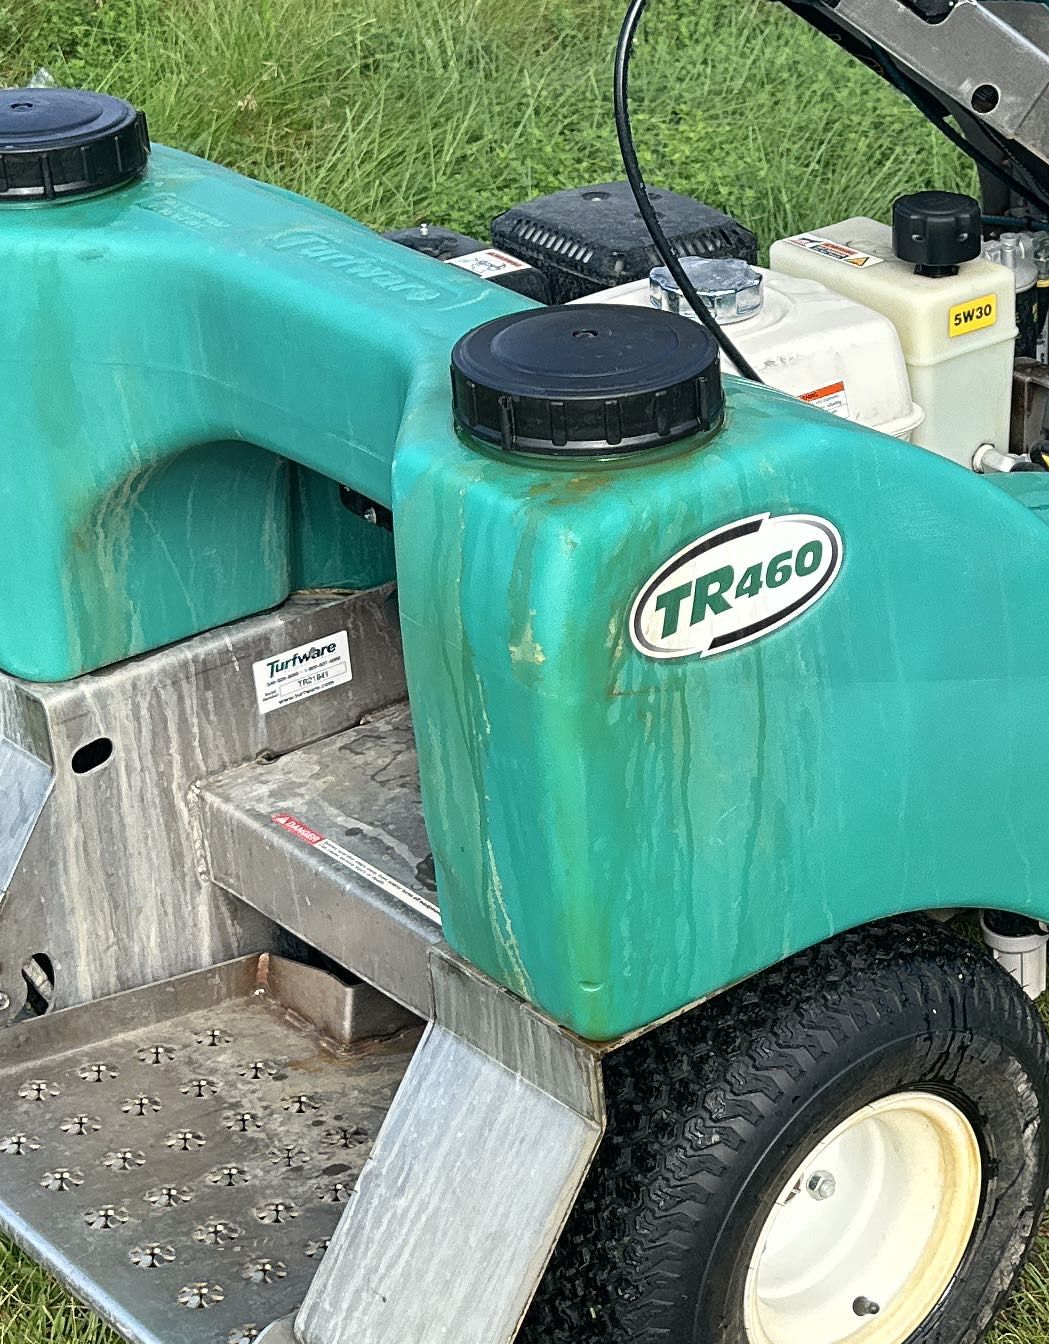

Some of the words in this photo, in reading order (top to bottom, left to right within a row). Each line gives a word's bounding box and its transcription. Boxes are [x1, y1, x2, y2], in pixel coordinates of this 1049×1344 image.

[953, 303, 992, 326] 5W30
[655, 540, 823, 640] TR460
[266, 642, 336, 678] Turfware
[286, 820, 321, 845] DANGER
